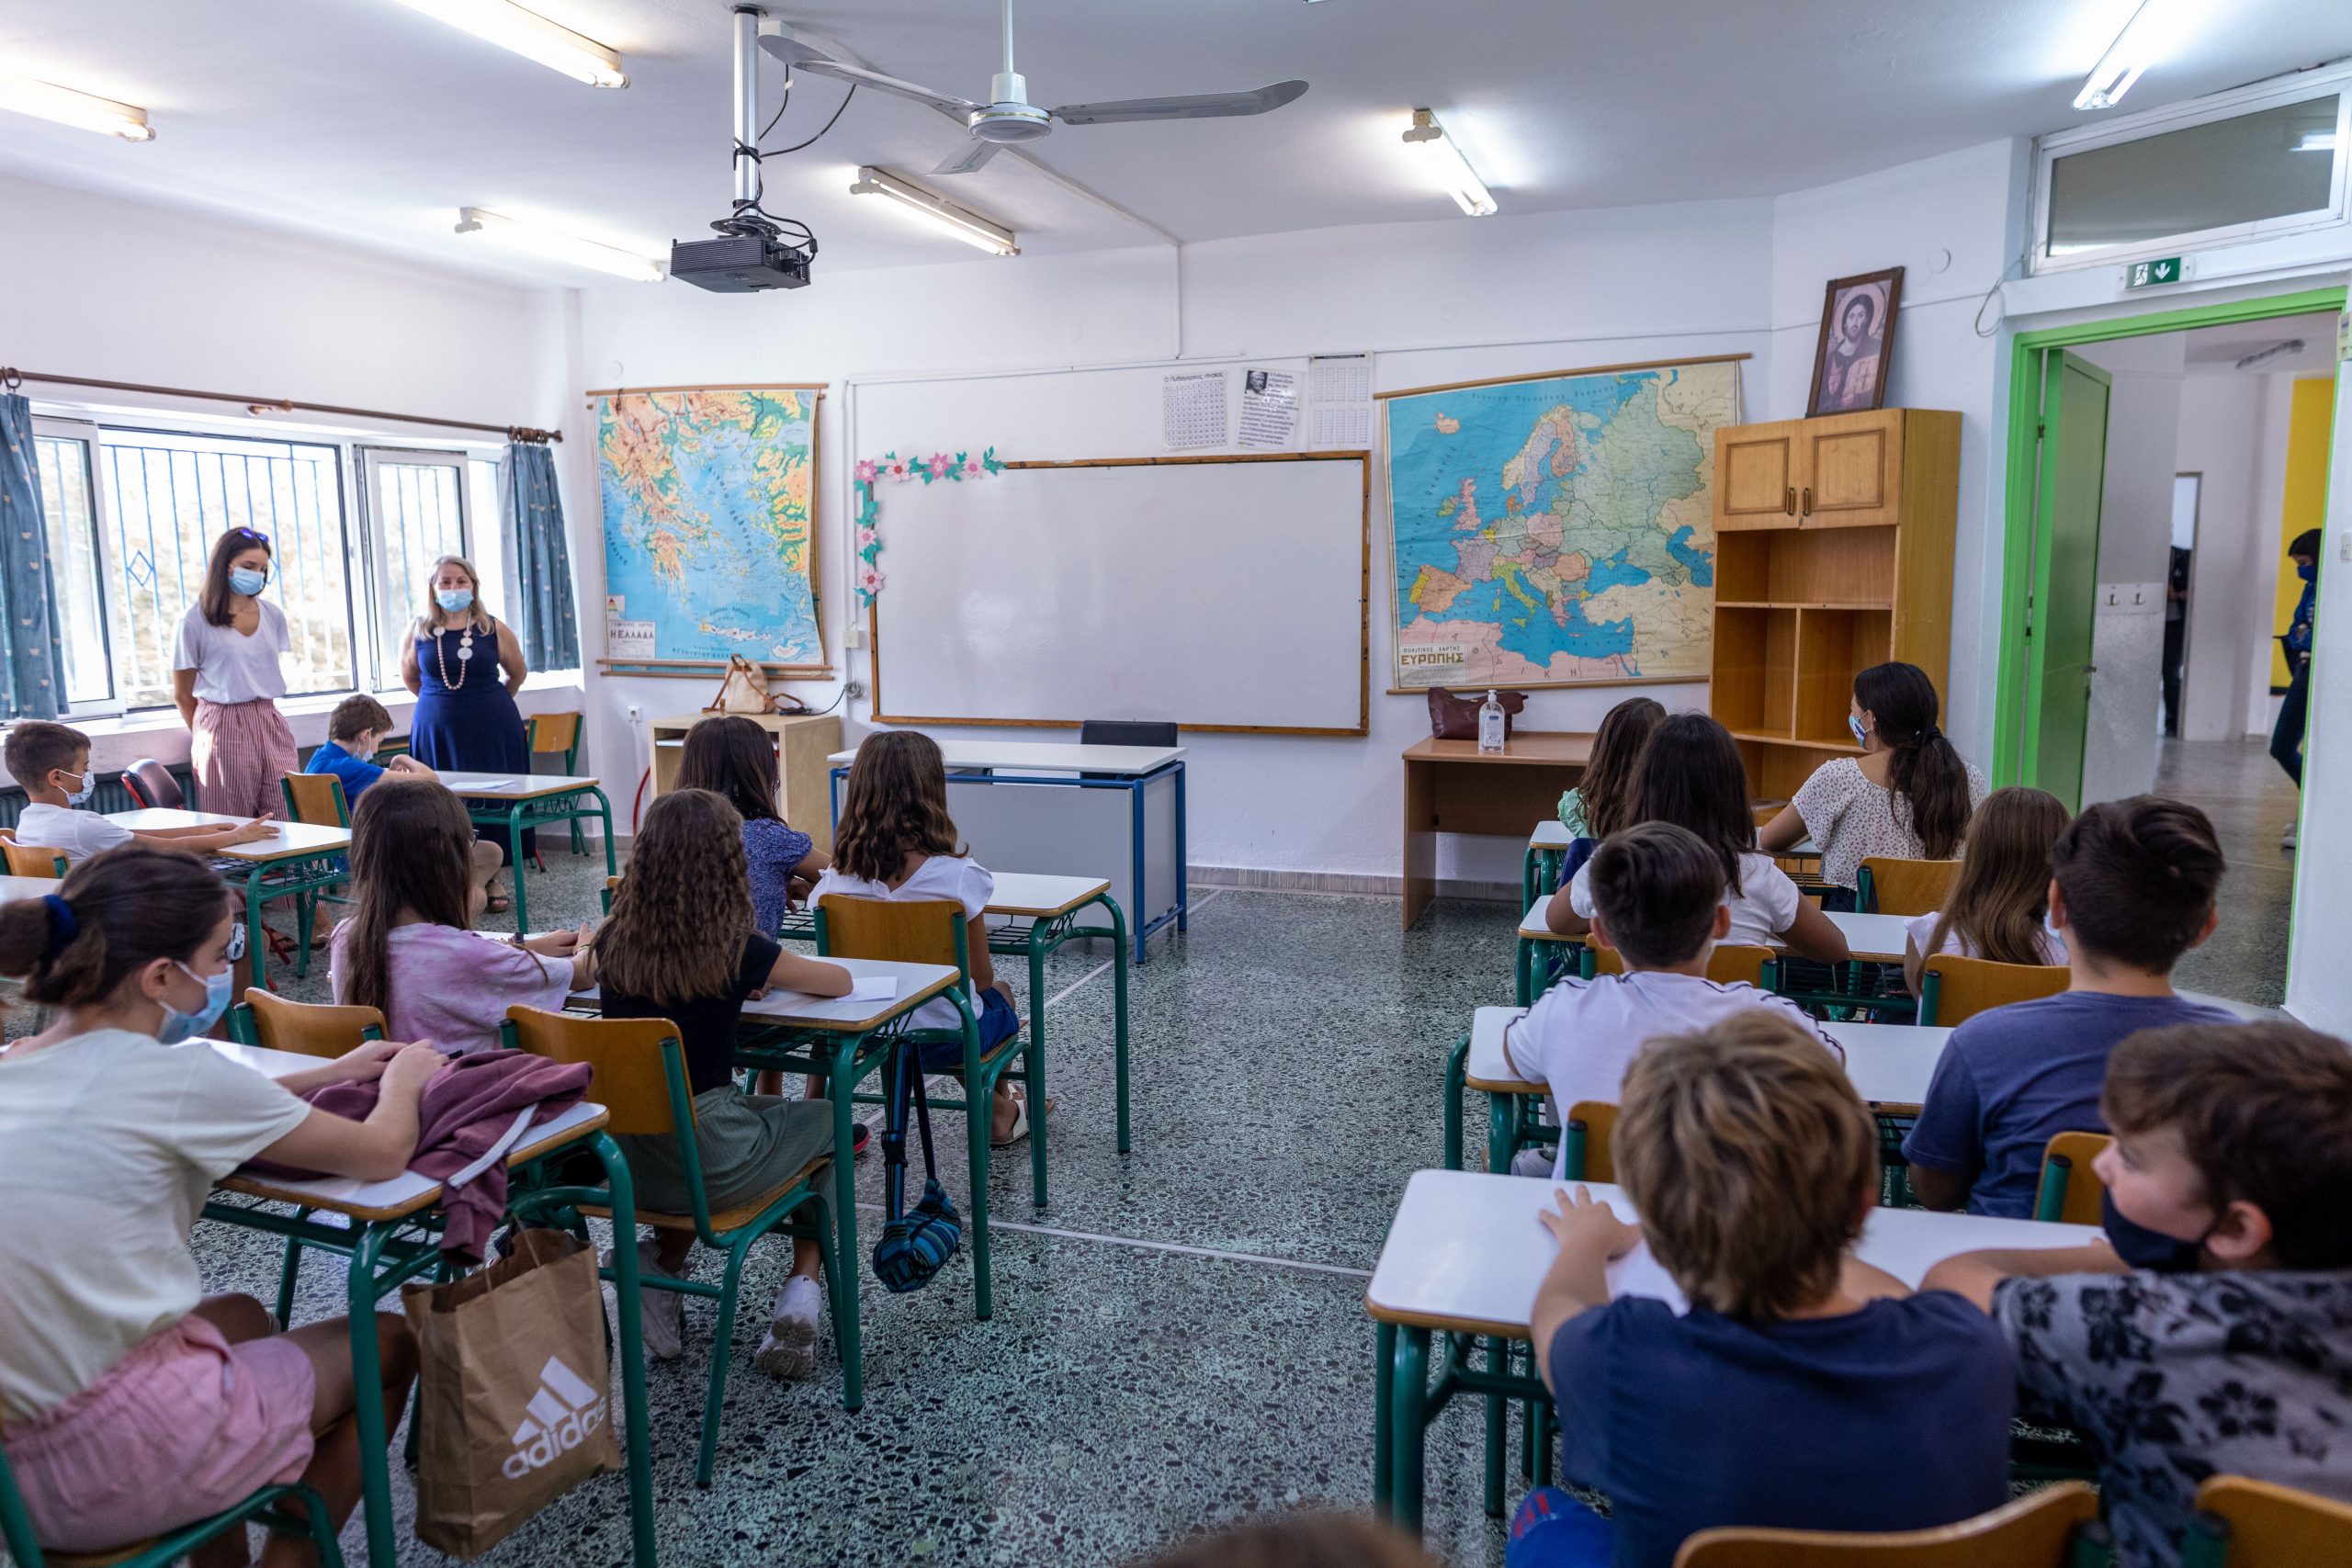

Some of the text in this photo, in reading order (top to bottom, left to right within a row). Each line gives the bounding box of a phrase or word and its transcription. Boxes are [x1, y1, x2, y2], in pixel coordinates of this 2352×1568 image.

[617, 629, 654, 639] ΕΛΛΑΔΑ
[1400, 652, 1464, 666] ΕΥΡΩΠΗΣ
[502, 1395, 606, 1480] adidas
